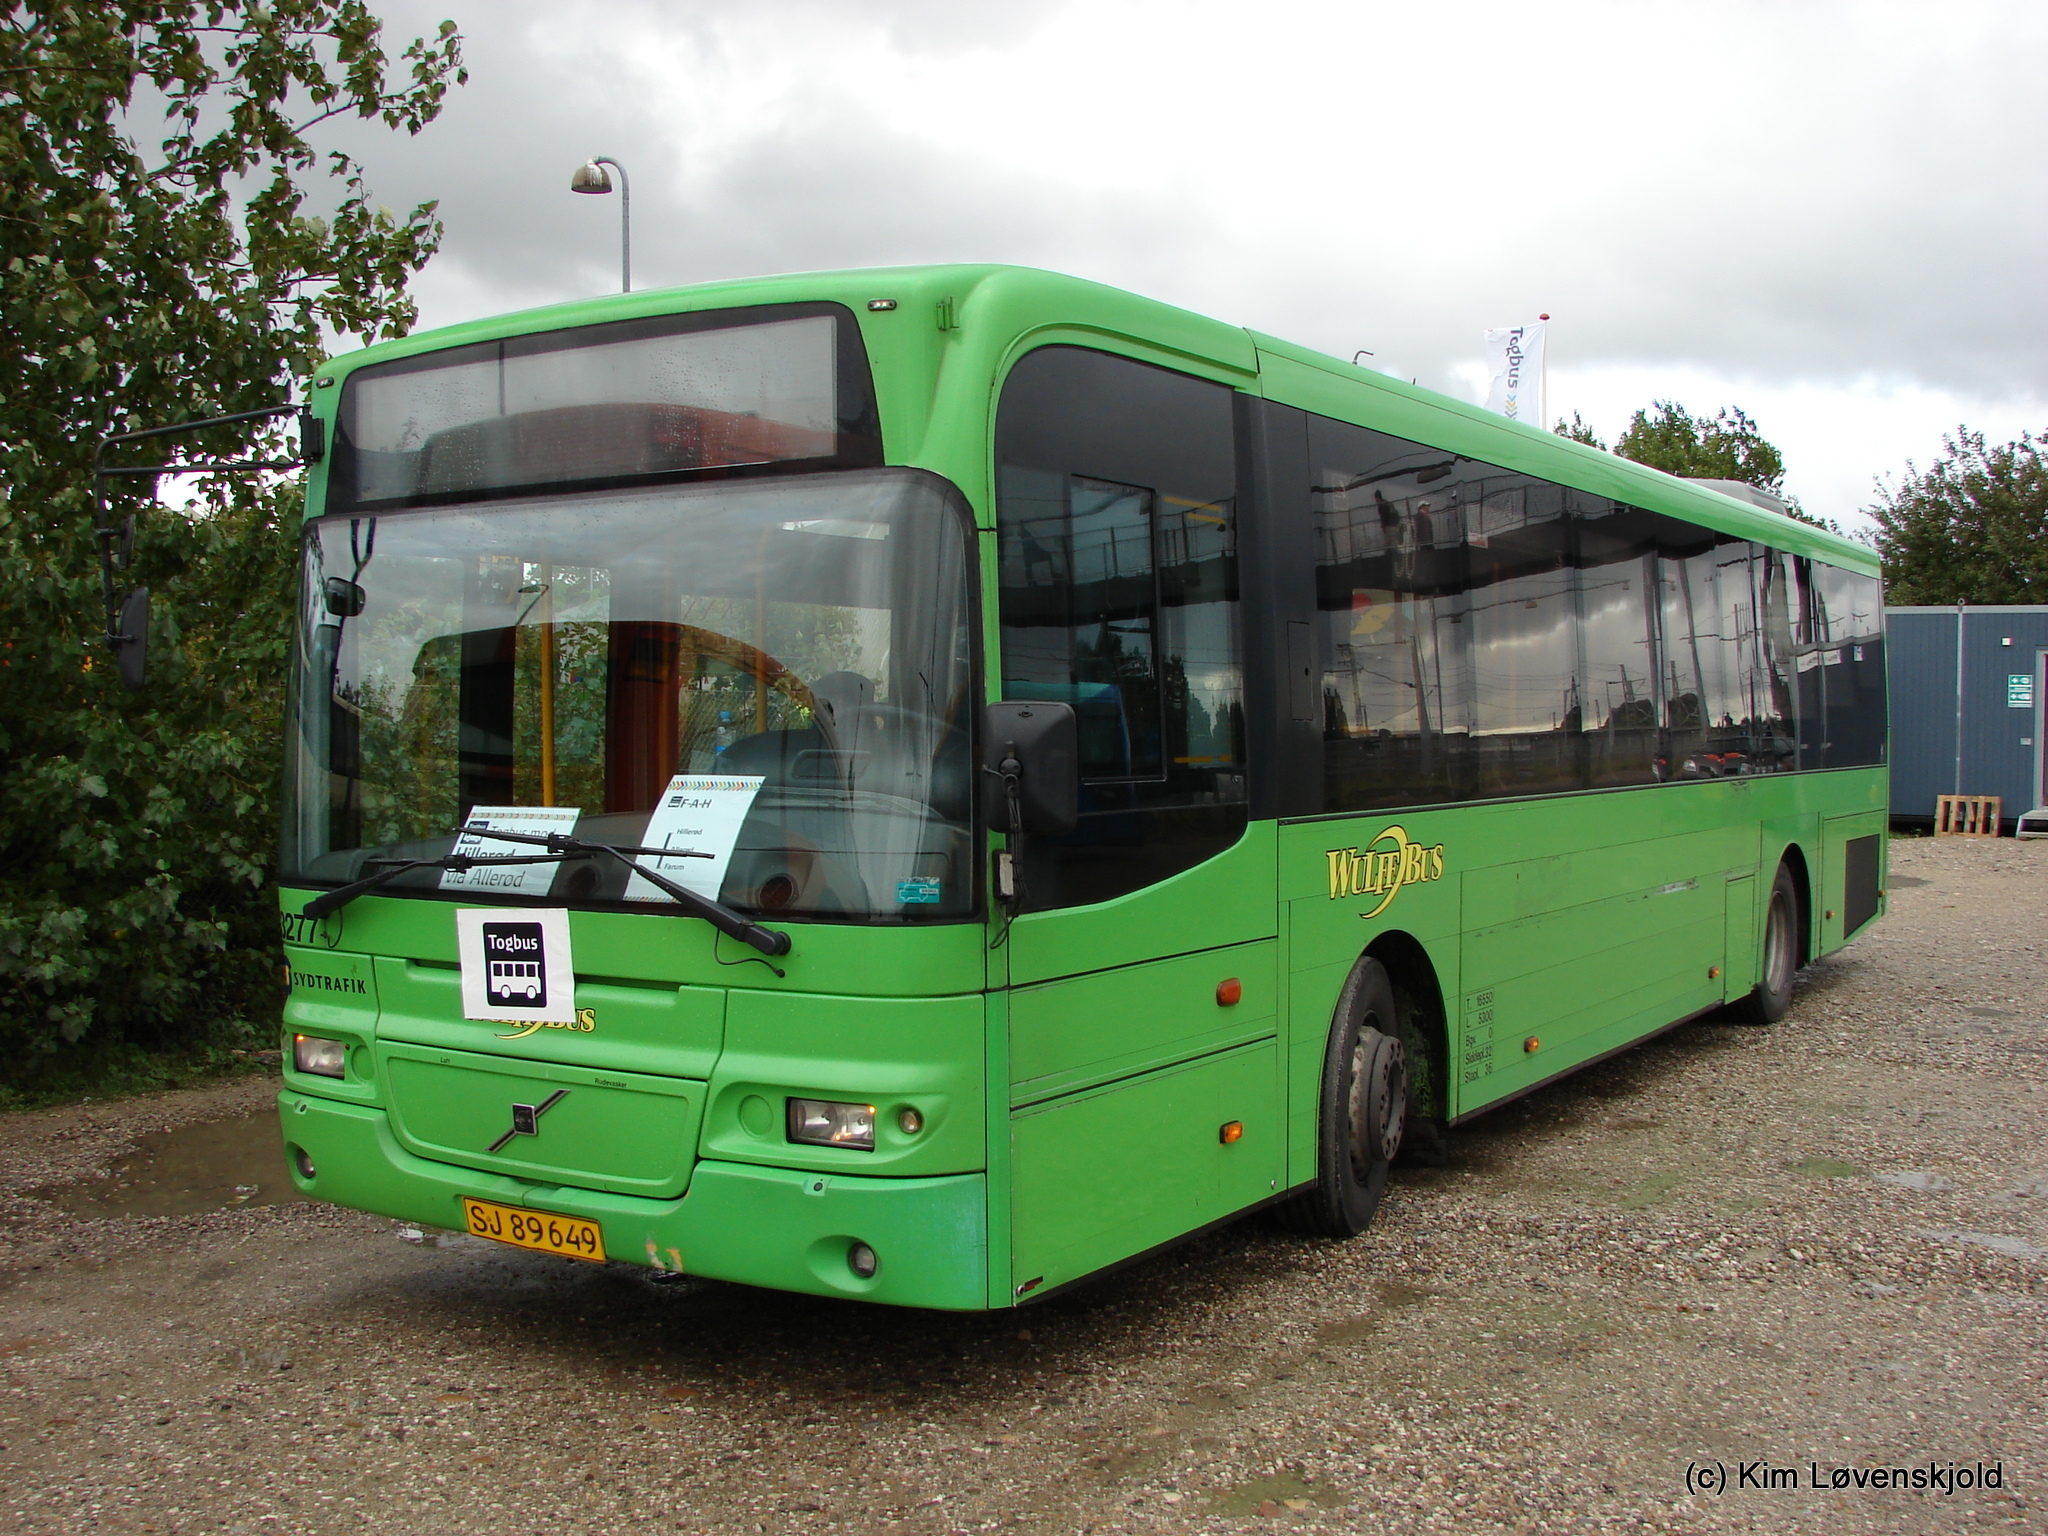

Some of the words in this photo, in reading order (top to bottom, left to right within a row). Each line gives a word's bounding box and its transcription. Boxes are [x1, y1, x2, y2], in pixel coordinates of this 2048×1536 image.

[1506, 327, 1524, 388] Togbus
[680, 799, 712, 808] F-A-H
[470, 868, 526, 887] Allerød
[488, 934, 538, 952] Togbus
[294, 972, 366, 994] SYDTRAFIK
[470, 1205, 502, 1235] SJ
